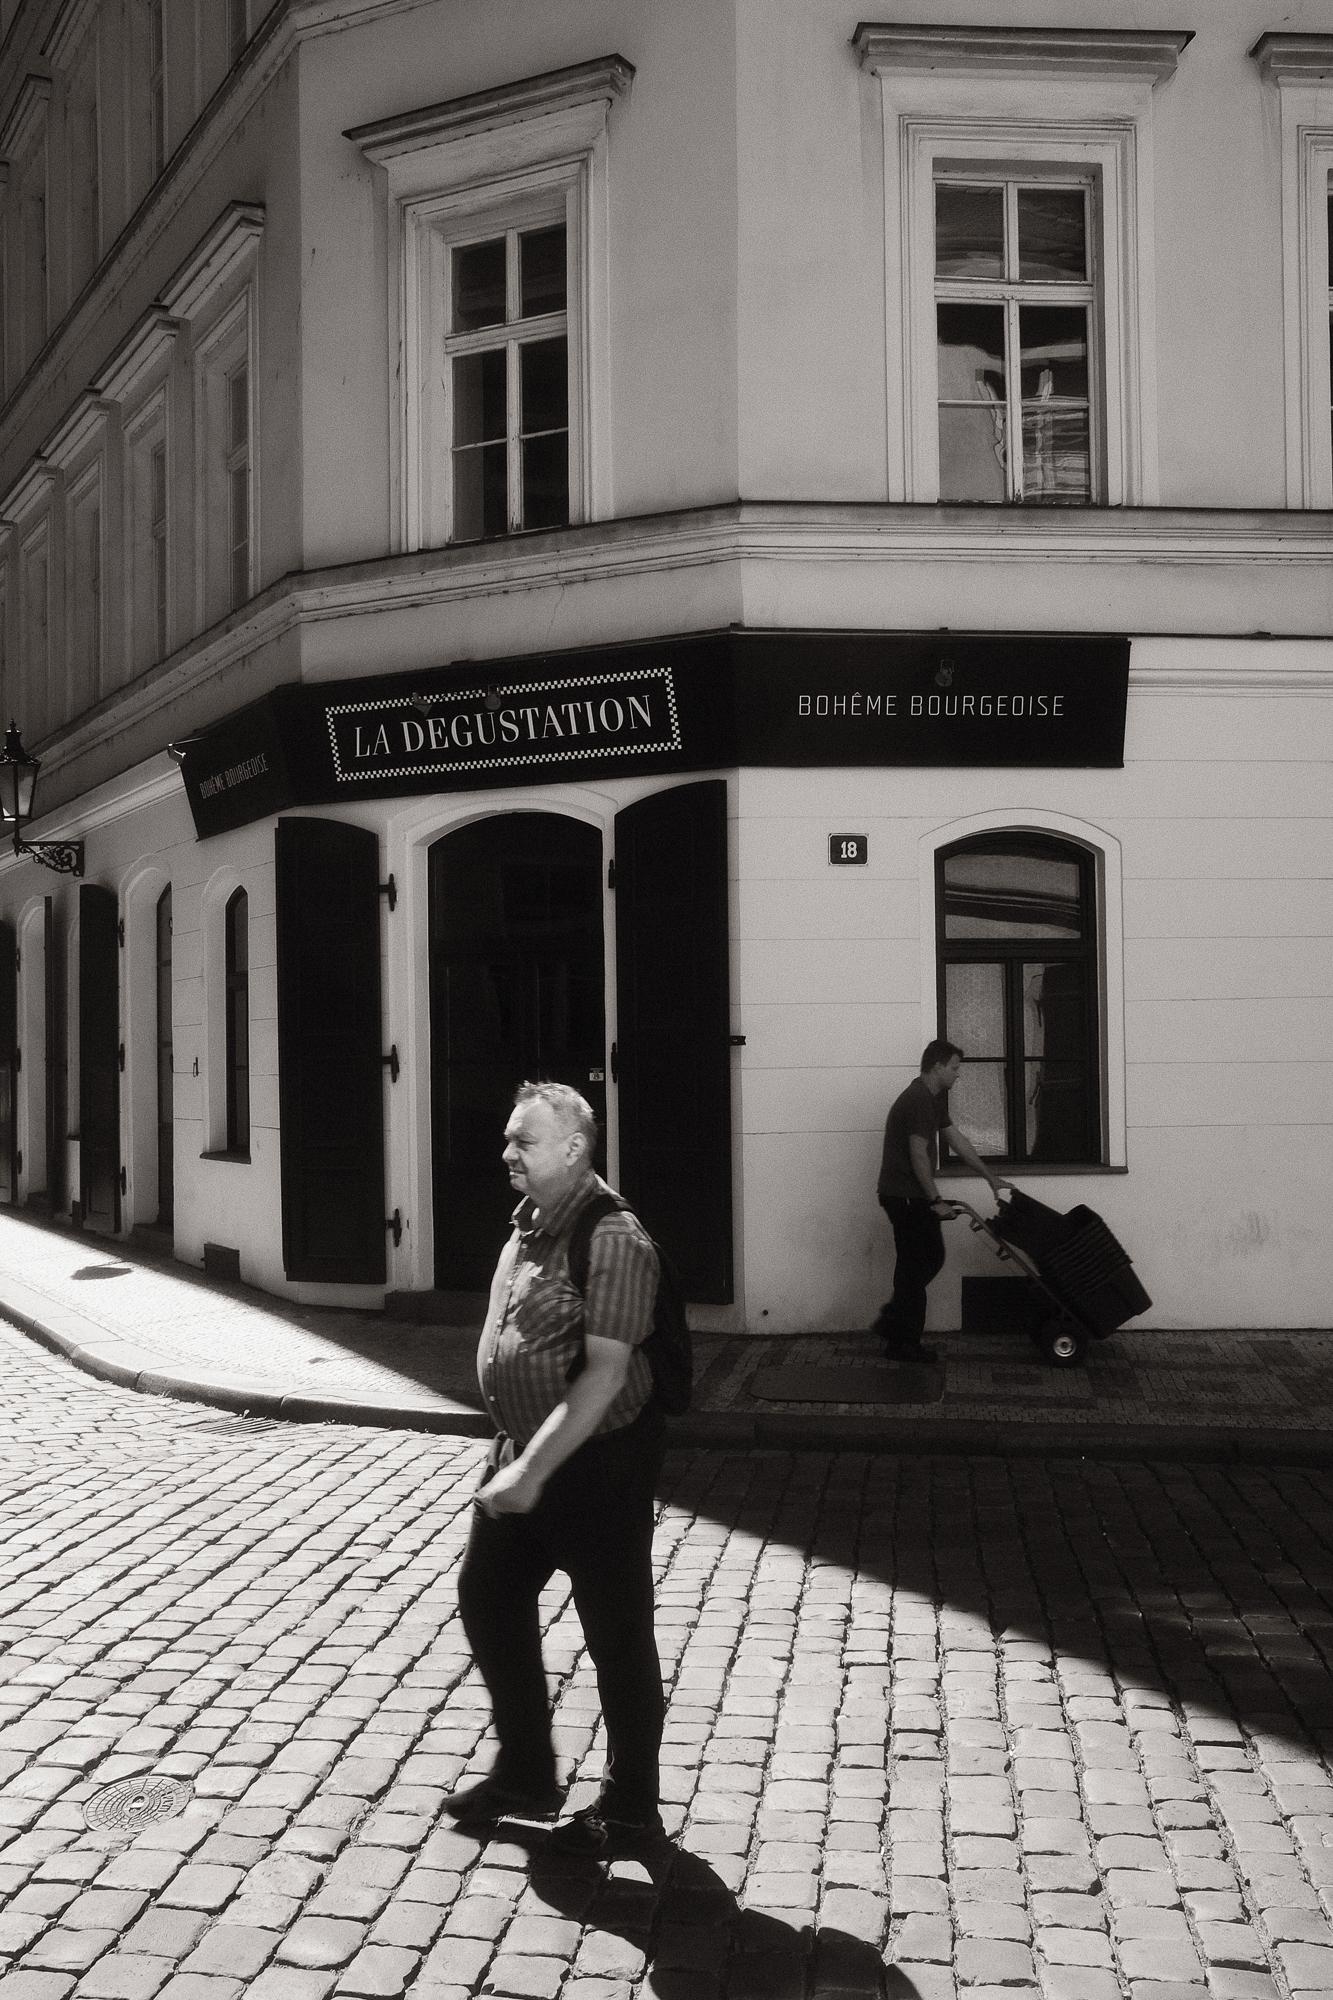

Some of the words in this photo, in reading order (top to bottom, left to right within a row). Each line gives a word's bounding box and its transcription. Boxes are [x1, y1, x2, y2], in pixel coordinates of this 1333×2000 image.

[798, 691, 897, 716] BOHÊME
[910, 695, 1065, 716] BOURGEOISE
[354, 723, 391, 757] LA
[401, 694, 653, 753] DEGUSTATION
[225, 753, 269, 787] BOURGEOISE
[840, 841, 858, 858] 18
